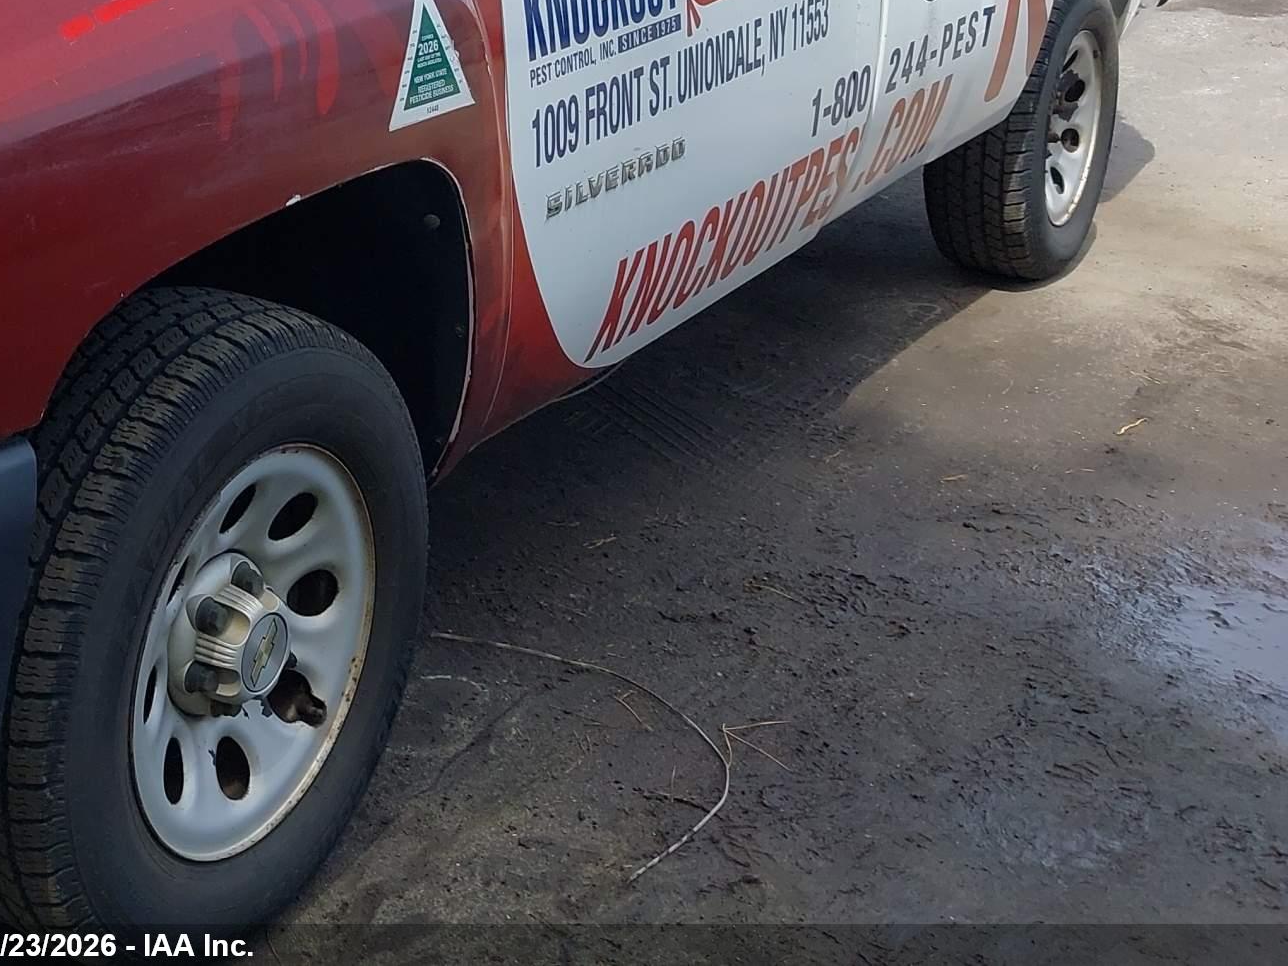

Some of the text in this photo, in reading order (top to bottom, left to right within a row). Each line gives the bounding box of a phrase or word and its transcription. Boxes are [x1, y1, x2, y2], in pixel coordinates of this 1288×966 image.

[418, 39, 439, 56] 2026
[530, 18, 677, 88] PEST CONTROL, INC. SINCE 1975
[532, 95, 579, 168] 1009
[585, 66, 644, 145] FRONT
[649, 55, 673, 117] ST.
[677, 17, 765, 104] UNIONDALE,
[769, 6, 789, 63] NY
[811, 5, 997, 137] 1-800 244-PEST
[546, 136, 686, 221] SILVERADO
[585, 74, 953, 363] KNOCKOUTPES.COM
